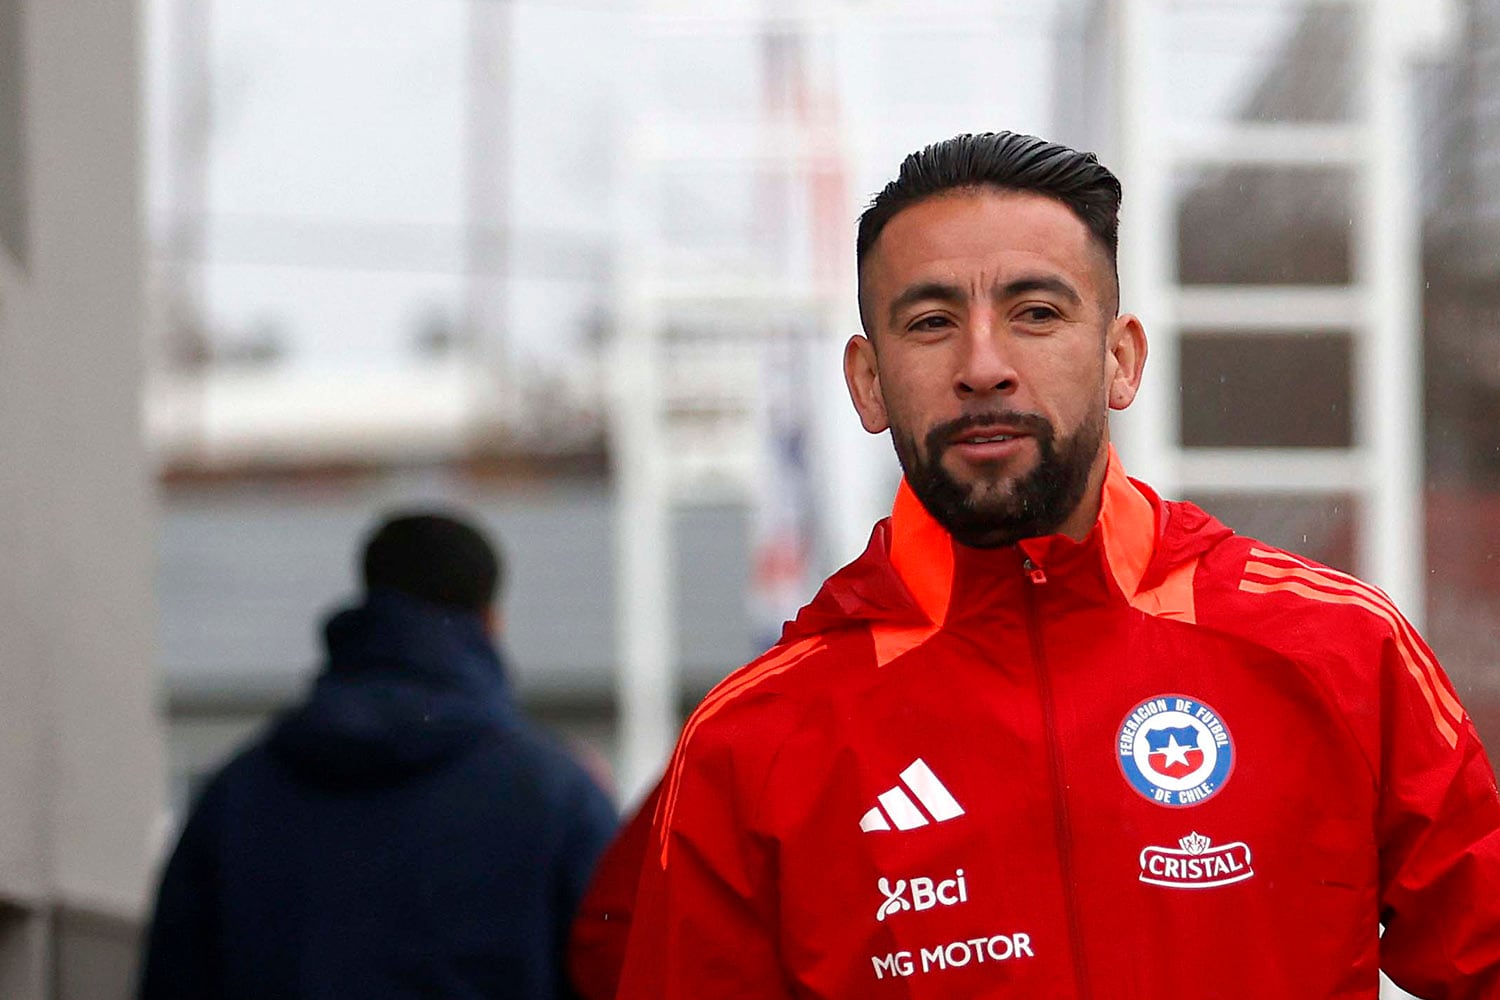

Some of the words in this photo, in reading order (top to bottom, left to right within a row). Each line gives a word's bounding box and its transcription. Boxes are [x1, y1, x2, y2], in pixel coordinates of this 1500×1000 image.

[1121, 699, 1167, 756] FEDERACION
[1175, 699, 1192, 713] DE
[1195, 706, 1229, 748] FUTBOL
[1154, 789, 1171, 803] DE
[1179, 782, 1213, 804] CHILE
[1149, 852, 1244, 879] CRISTAL
[910, 869, 967, 912] Bci
[871, 953, 914, 979] MG
[921, 932, 1034, 973] MOTOR
